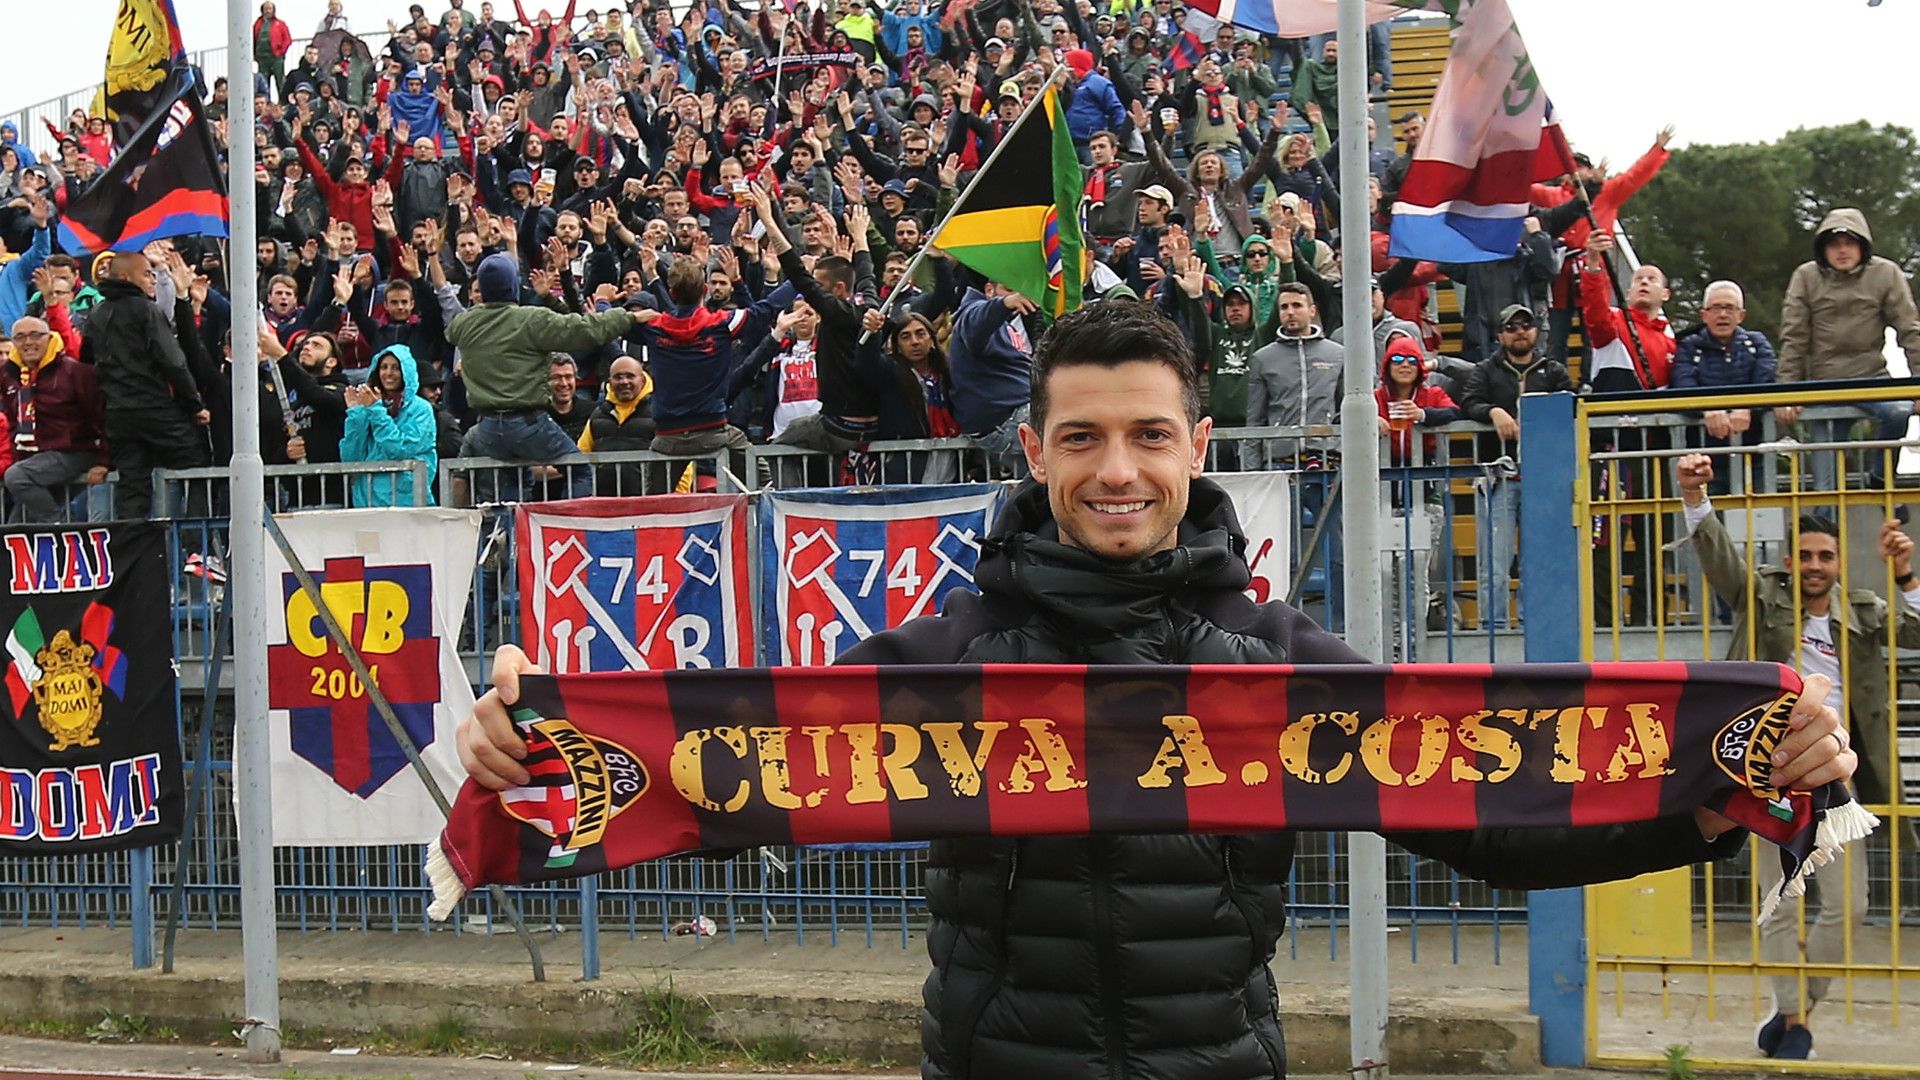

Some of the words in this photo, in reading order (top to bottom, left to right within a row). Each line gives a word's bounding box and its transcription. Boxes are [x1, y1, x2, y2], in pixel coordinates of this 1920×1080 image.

[4, 529, 114, 595] MAI
[599, 555, 669, 605] 74
[848, 546, 922, 598] 74
[285, 580, 410, 658] CTB
[51, 697, 87, 714] DOMI
[54, 680, 82, 696] MAI
[669, 717, 1088, 813] CURVA
[1720, 717, 1756, 761] BFC
[0, 752, 161, 842] DOMI
[549, 728, 606, 836] MAZZINI
[605, 752, 640, 795] BFC
